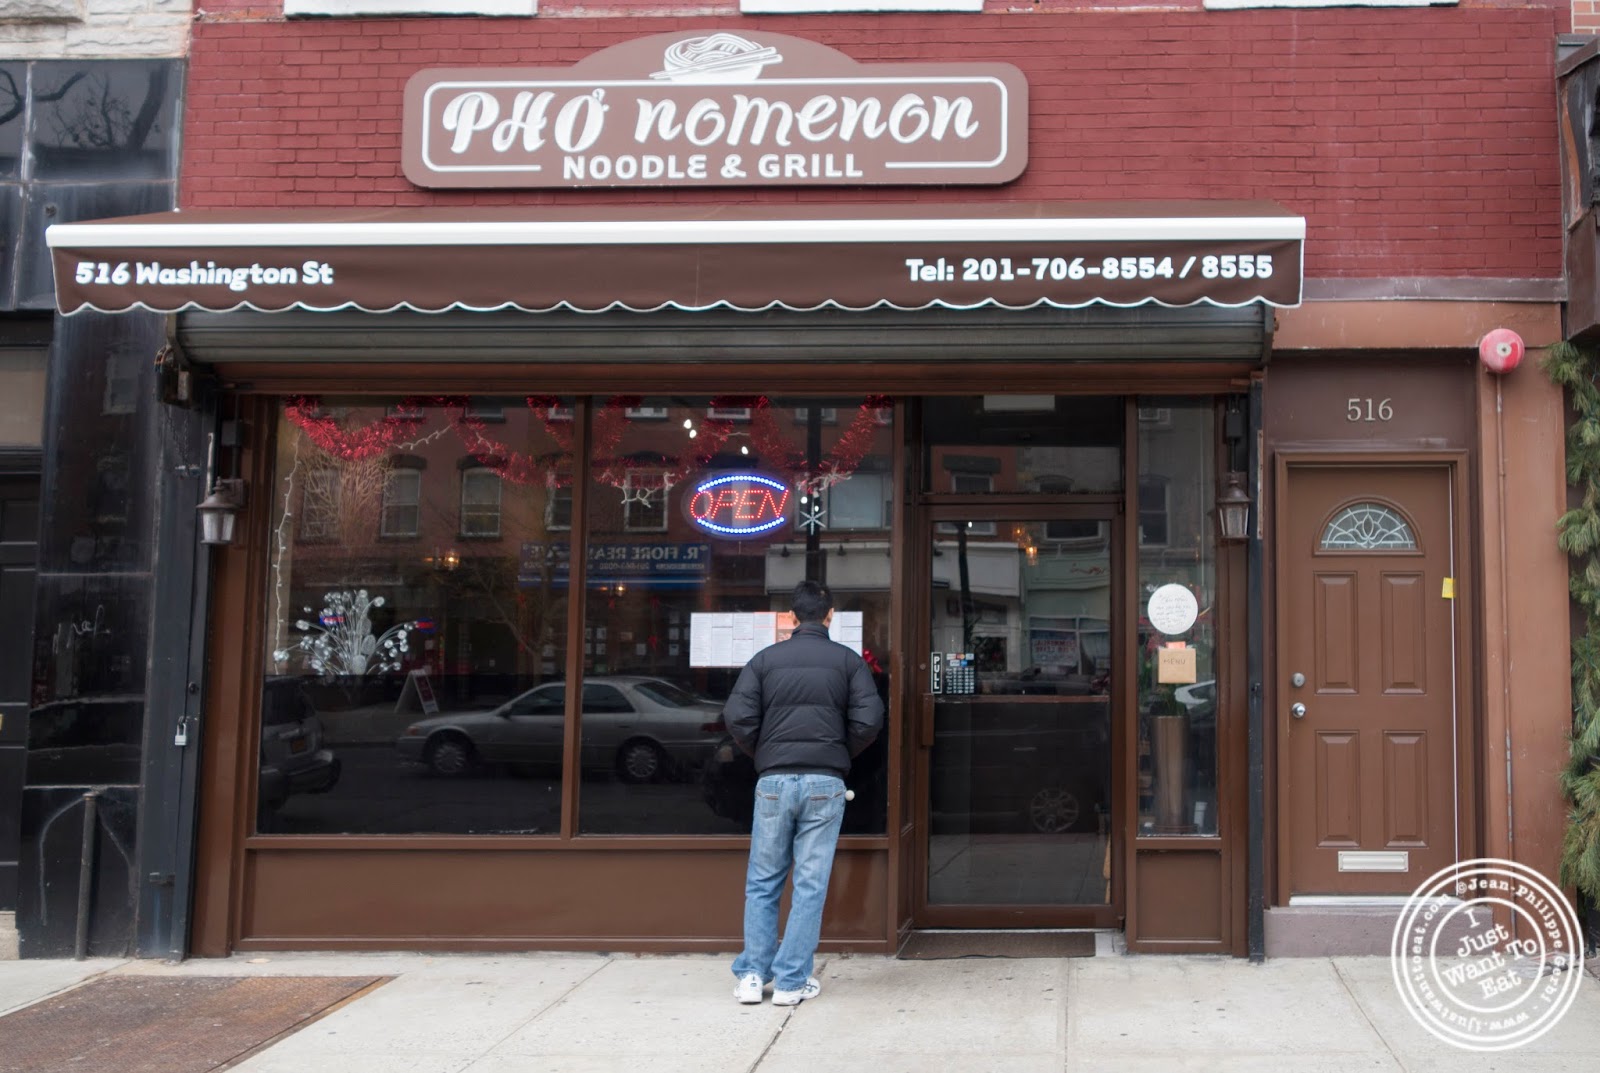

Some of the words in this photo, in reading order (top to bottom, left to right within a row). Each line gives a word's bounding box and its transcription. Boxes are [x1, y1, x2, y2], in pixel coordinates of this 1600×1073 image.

[634, 91, 979, 147] nomenon
[563, 154, 707, 180] NOODLE
[720, 154, 747, 178] &
[758, 153, 863, 178] GRILL
[75, 261, 130, 284] 516
[135, 261, 297, 291] Washington
[302, 261, 334, 285] St
[905, 258, 954, 281] Tel:
[962, 256, 1174, 281] 201-706-8554
[1179, 256, 1196, 278] /
[1202, 255, 1273, 279] 8555
[1347, 398, 1393, 421] 516
[690, 489, 790, 519] OPEN
[1163, 657, 1186, 665] MENU
